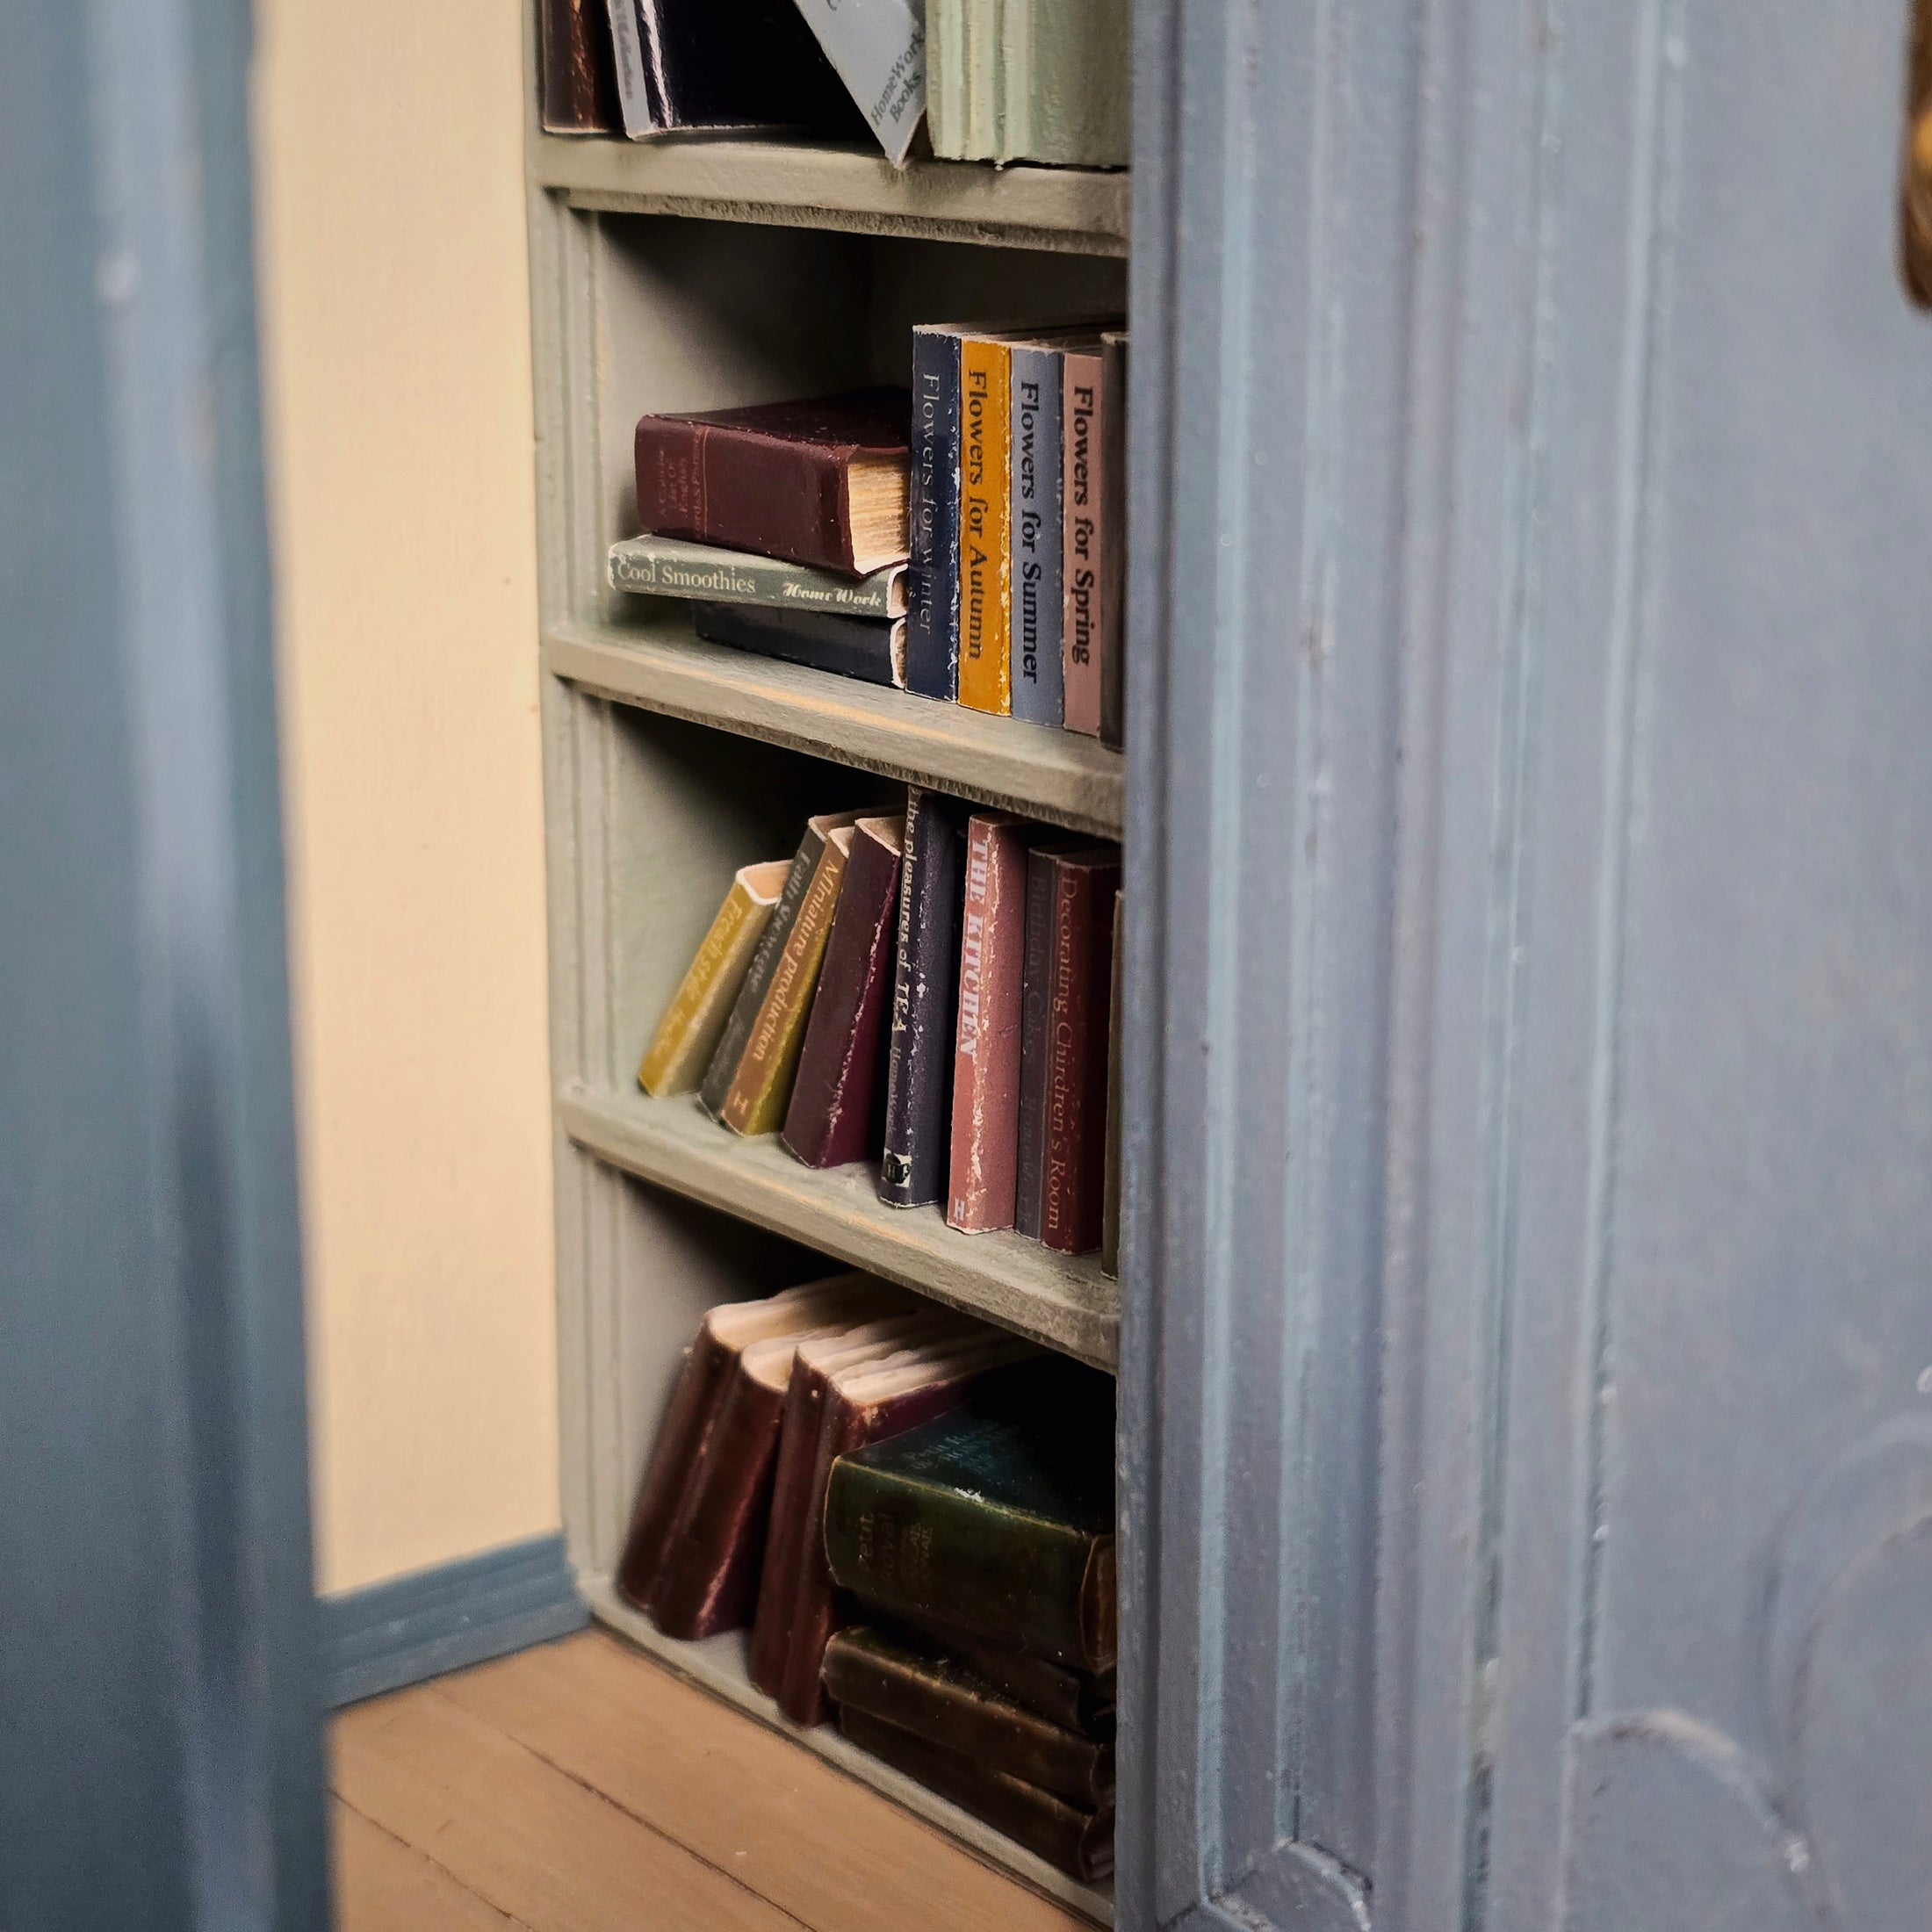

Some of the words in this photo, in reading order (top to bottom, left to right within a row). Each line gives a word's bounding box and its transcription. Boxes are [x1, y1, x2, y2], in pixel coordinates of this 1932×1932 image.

[890, 72, 921, 124] Books
[922, 372, 940, 486] Flowers
[969, 369, 988, 486] Flowers
[1020, 382, 1040, 500] Flowers
[1073, 386, 1094, 507] Flowers
[922, 496, 938, 538] for
[969, 496, 988, 539] for
[1021, 509, 1042, 553] for
[1074, 515, 1094, 561] for
[617, 560, 657, 583] Cool
[661, 566, 756, 593] Smoothies
[969, 544, 987, 660] Autumn
[1021, 561, 1042, 684] Summer
[1071, 568, 1094, 667] Spring
[906, 800, 919, 834] the
[898, 838, 917, 943] pleasures
[970, 840, 990, 905] THE
[898, 949, 912, 973] of
[1054, 876, 1078, 1013] Decorating
[753, 948, 799, 1062] production
[891, 982, 910, 1032] TEA
[960, 914, 984, 1056] KITCHEN
[954, 1198, 965, 1222] H
[1049, 1158, 1067, 1229] Room
